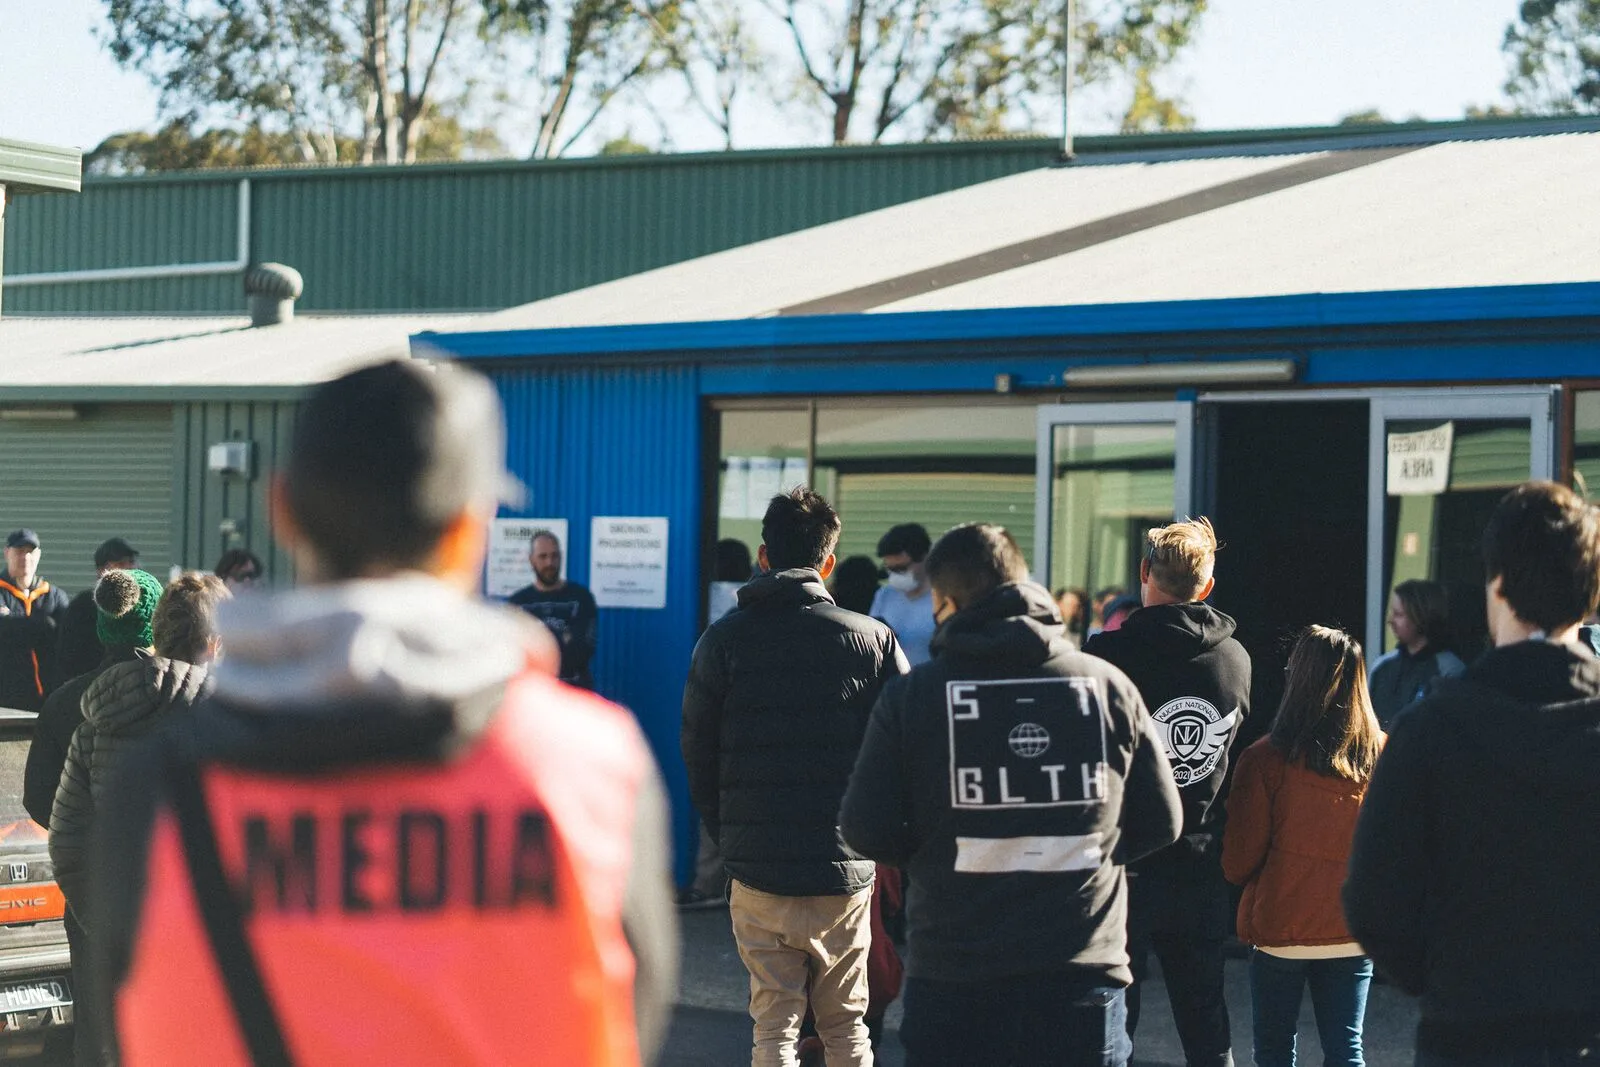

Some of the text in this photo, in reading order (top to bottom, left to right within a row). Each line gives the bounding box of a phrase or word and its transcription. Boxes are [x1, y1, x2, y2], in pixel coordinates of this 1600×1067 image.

[1185, 701, 1217, 721] NATIONALS
[1174, 770, 1191, 780] 2021
[243, 808, 557, 913] MEDIA
